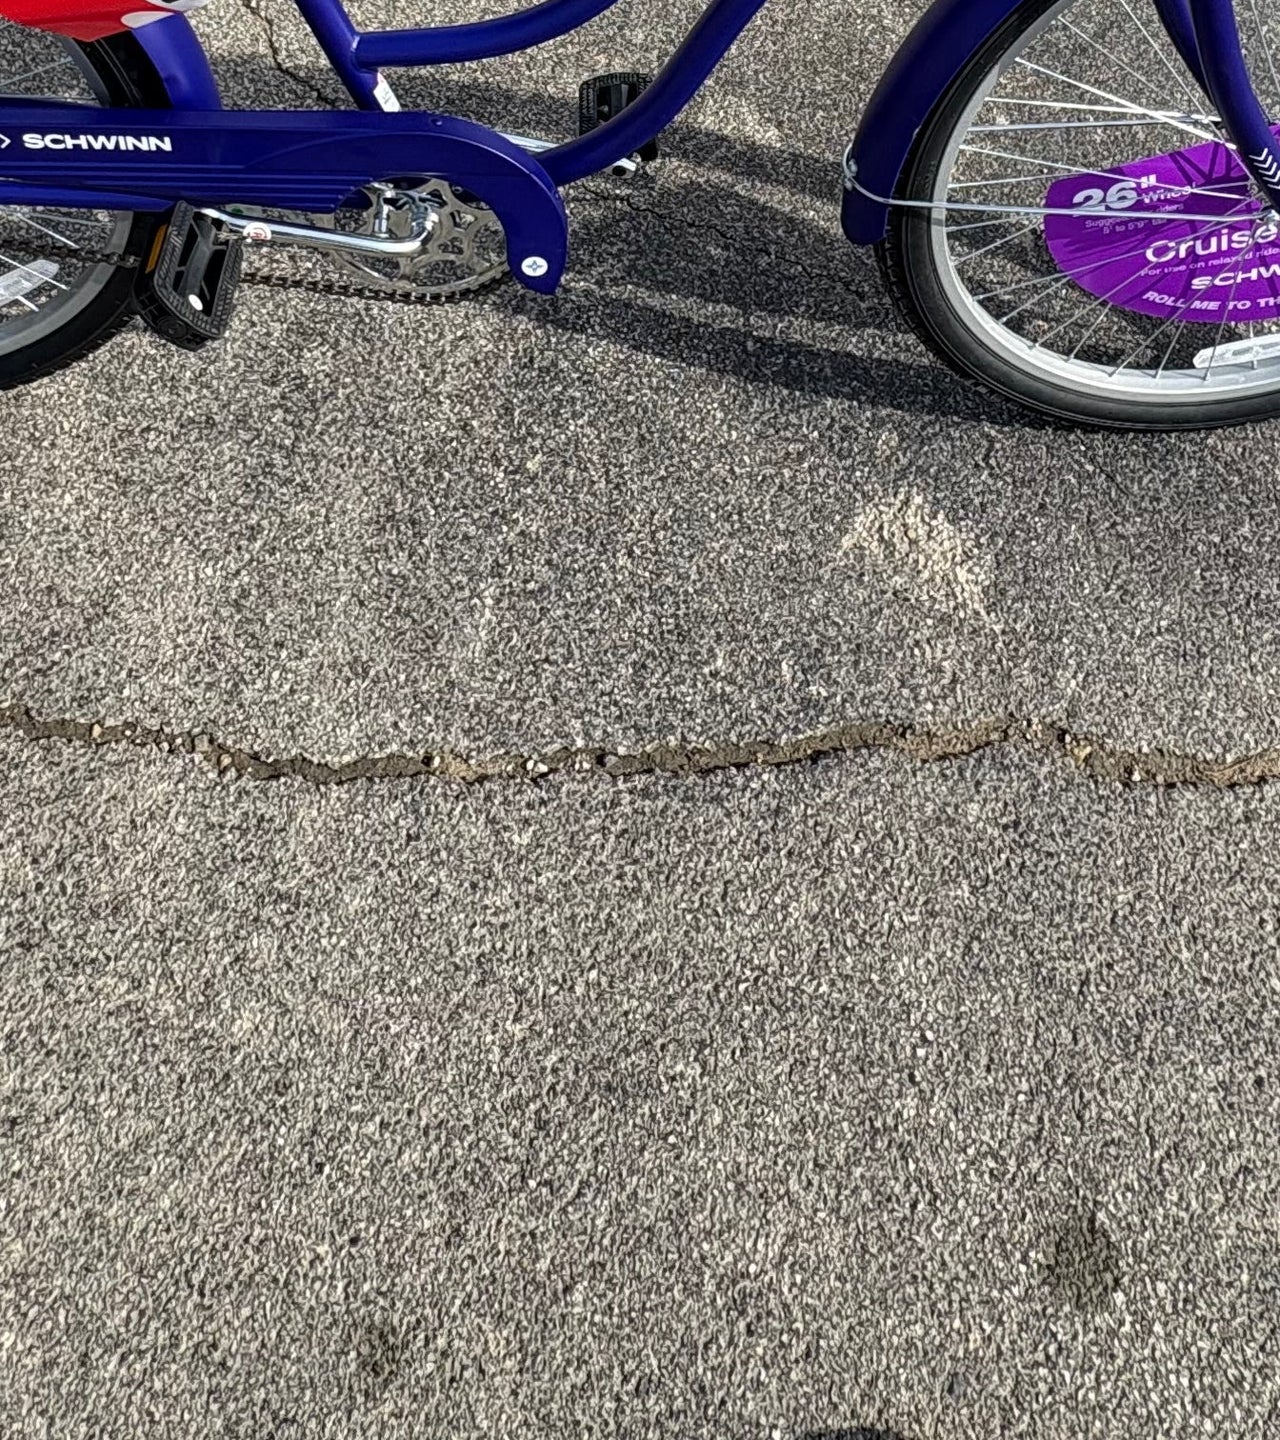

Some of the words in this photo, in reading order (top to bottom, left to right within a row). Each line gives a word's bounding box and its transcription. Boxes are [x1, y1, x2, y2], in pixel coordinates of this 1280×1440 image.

[22, 132, 174, 152] SCHWINN
[1072, 173, 1157, 218] 26"
[1142, 290, 1187, 309] ROLL
[1190, 299, 1222, 312] ME
[1227, 299, 1253, 312] TO
